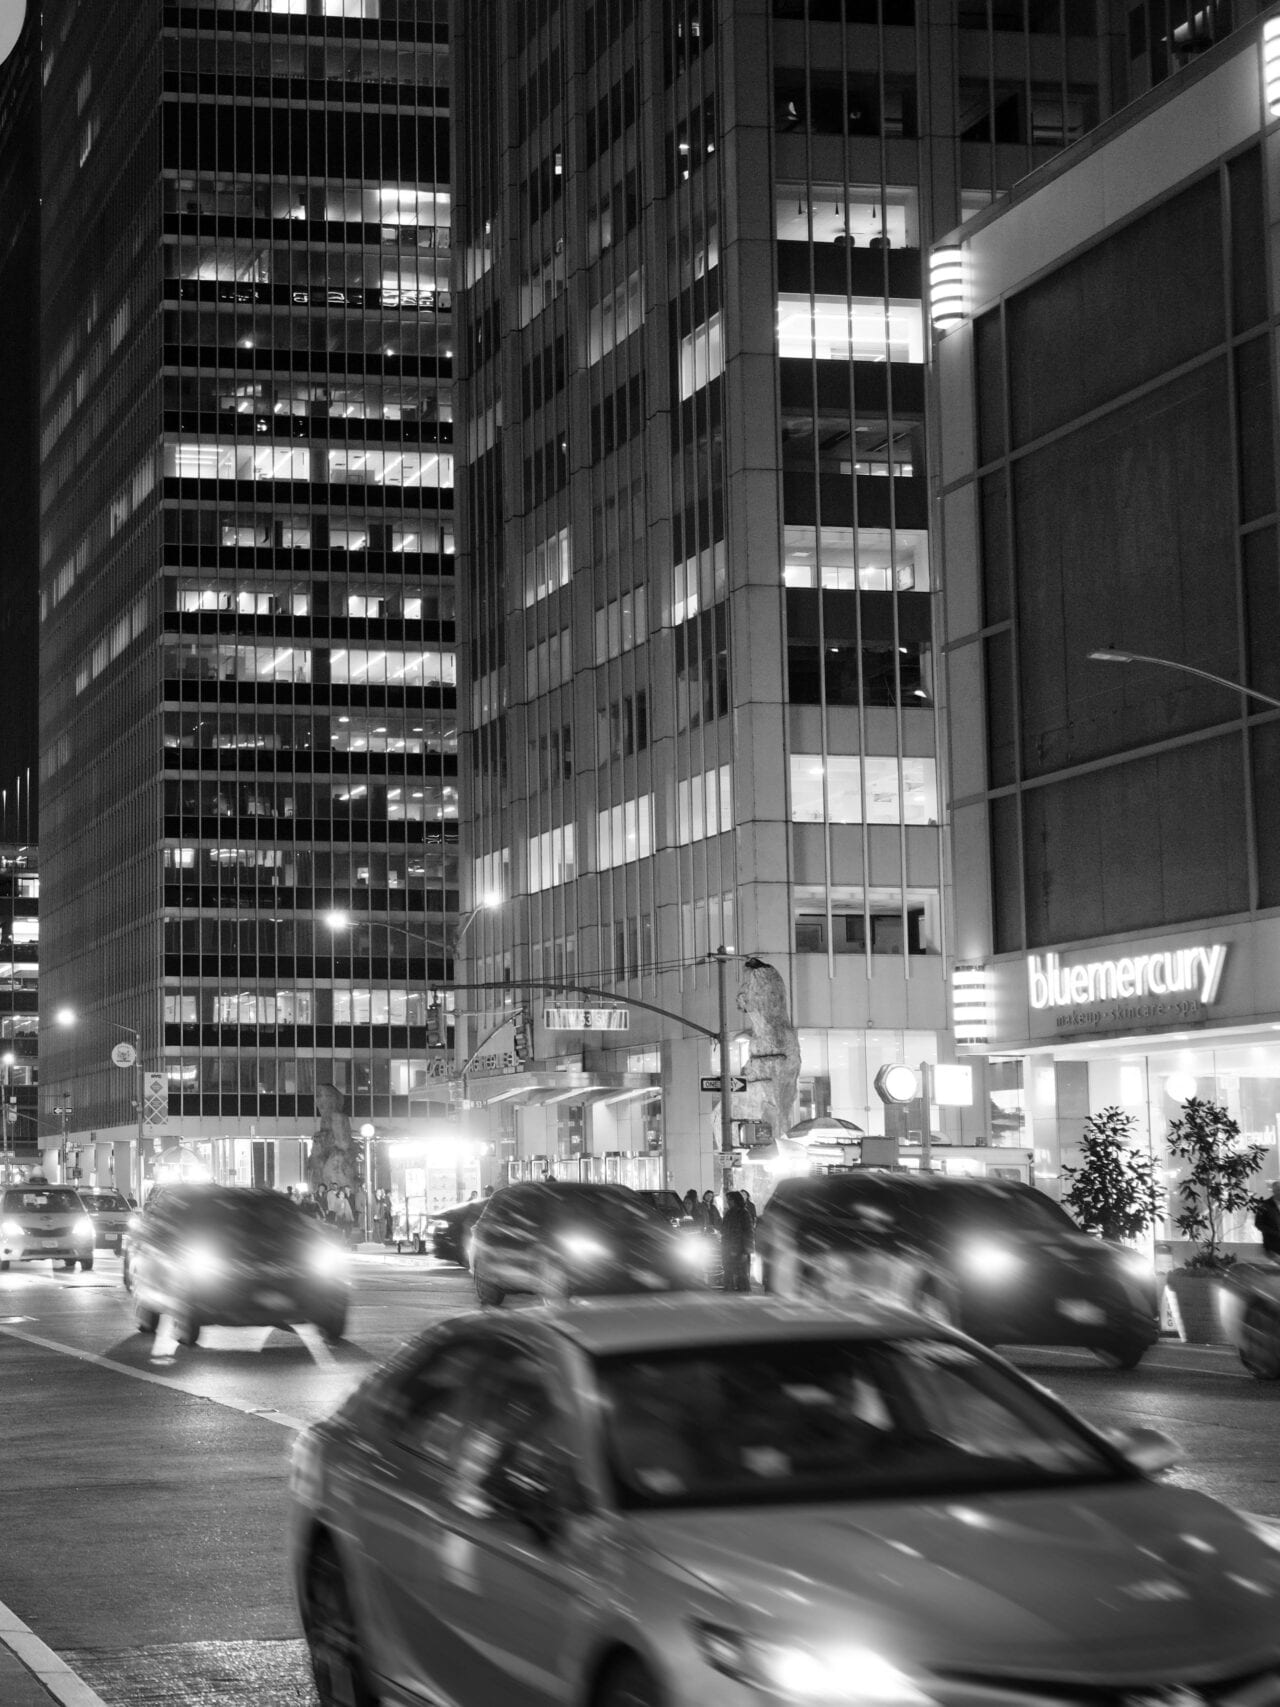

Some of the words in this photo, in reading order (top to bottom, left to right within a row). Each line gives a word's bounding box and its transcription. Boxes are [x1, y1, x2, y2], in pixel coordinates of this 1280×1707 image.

[1027, 944, 1227, 1009] bluemercury
[1056, 1009, 1101, 1028] makeup
[1111, 1000, 1166, 1021] skincare
[1175, 999, 1198, 1017] spa
